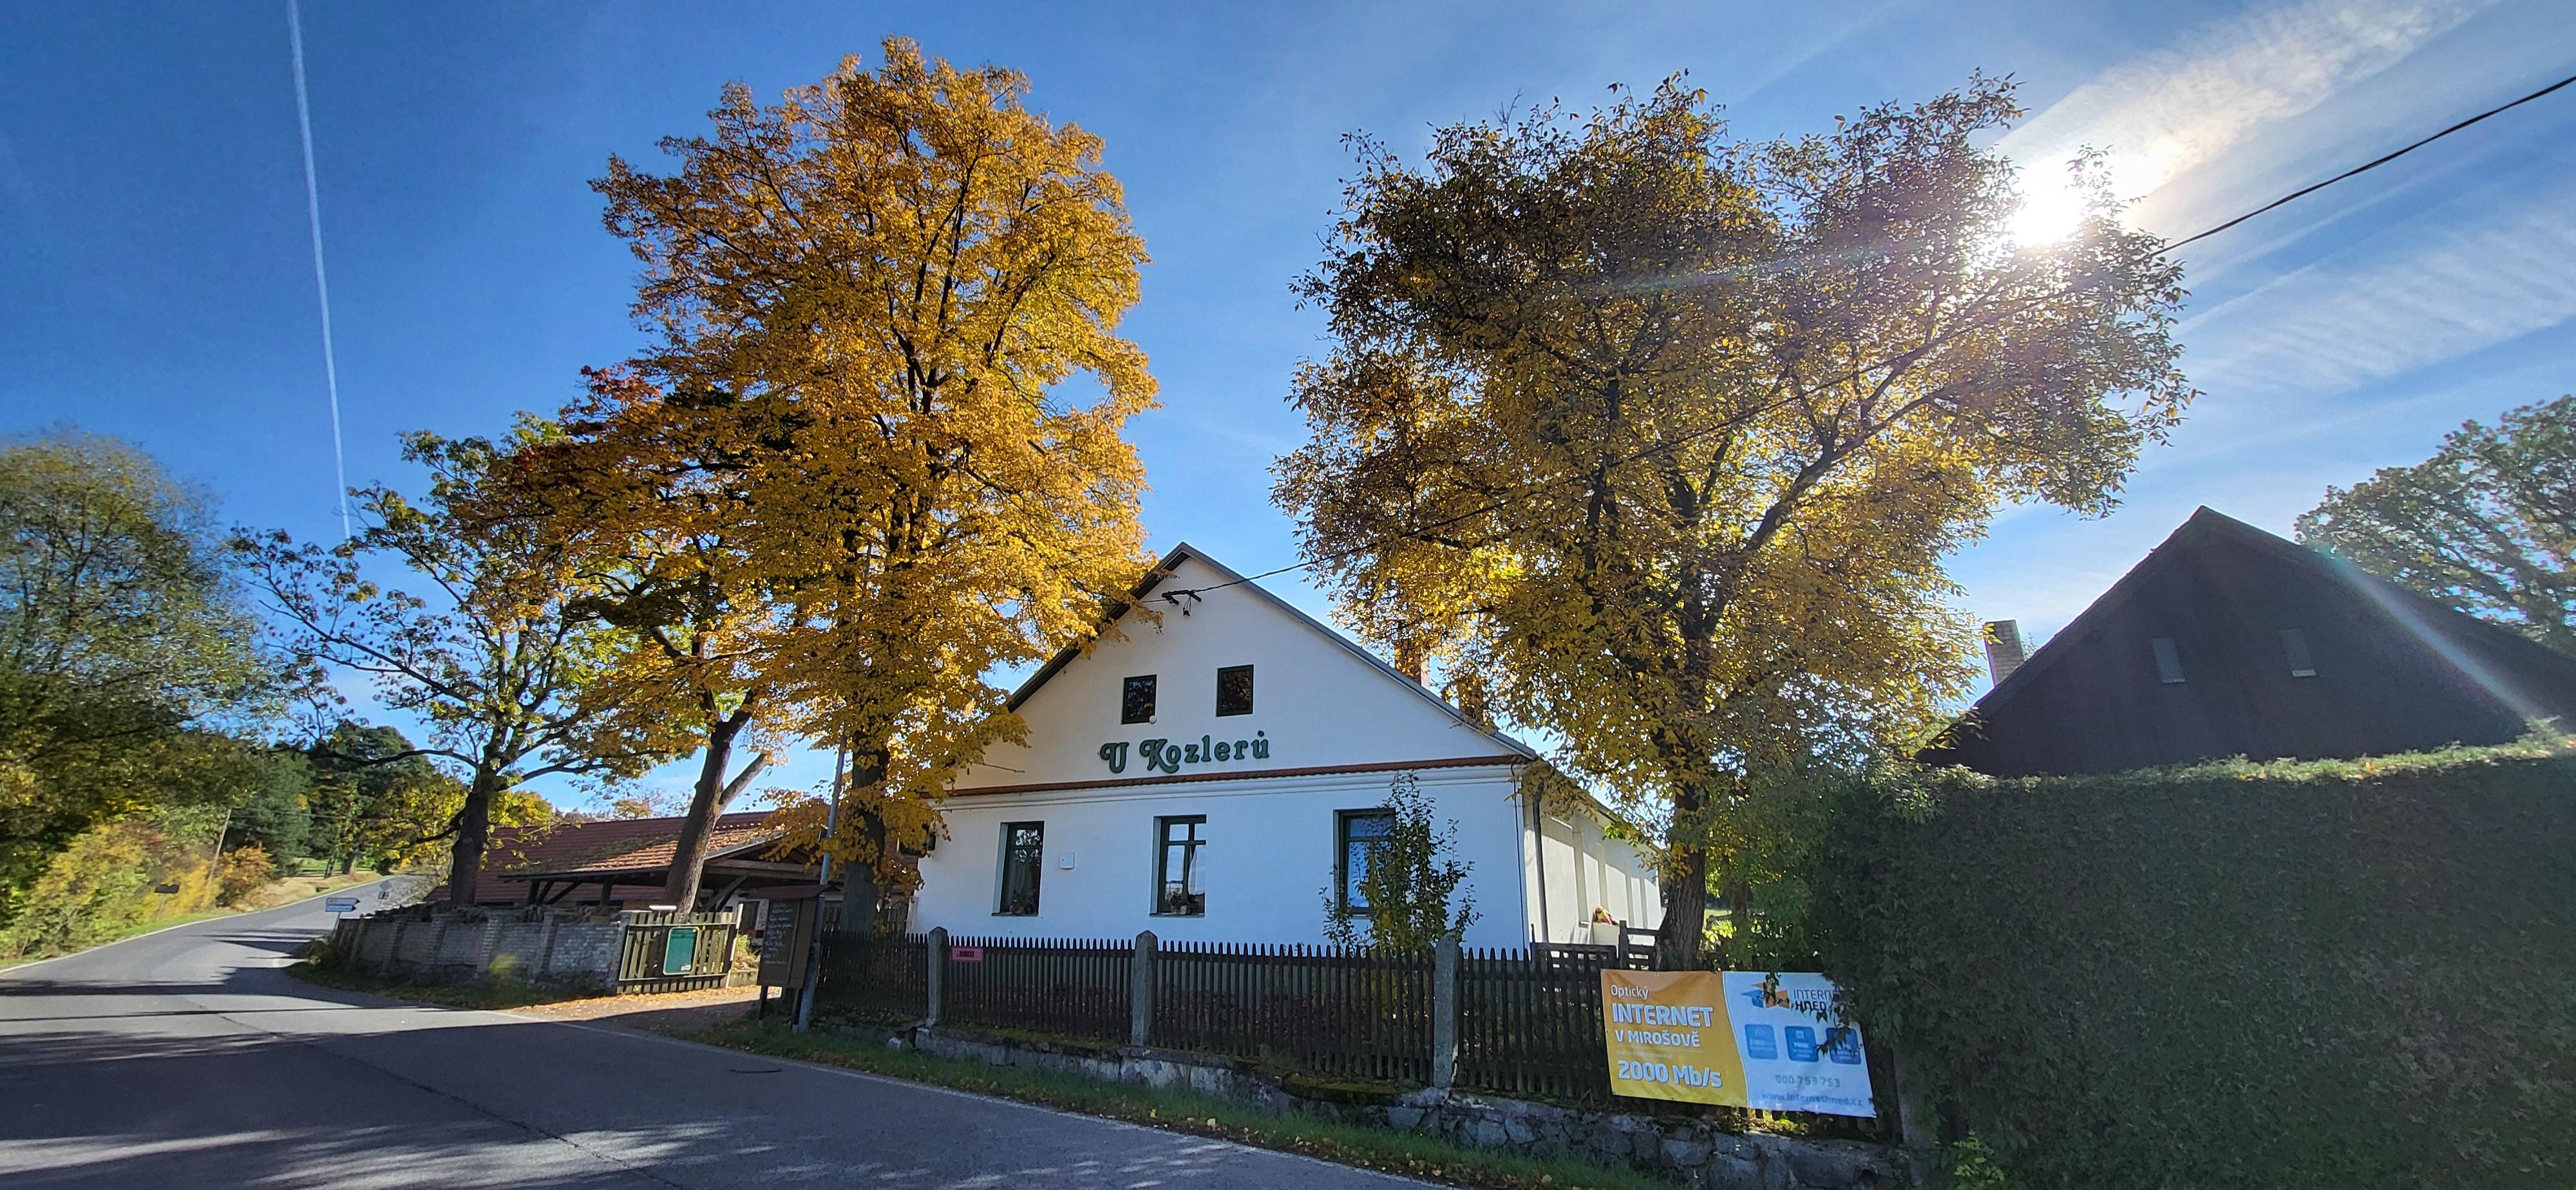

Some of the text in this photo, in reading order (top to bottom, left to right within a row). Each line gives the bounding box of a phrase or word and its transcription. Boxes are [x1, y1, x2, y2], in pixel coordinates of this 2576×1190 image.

[1099, 730, 1270, 773] U Kozlerů
[1611, 984, 1649, 1000] Optický
[1793, 989, 1840, 1001] INTERN
[1612, 1003, 1714, 1028] INTERNET
[1615, 1029, 1701, 1048] V MIROŠOVĚ
[1617, 1060, 1723, 1088] 2000 Mb/s
